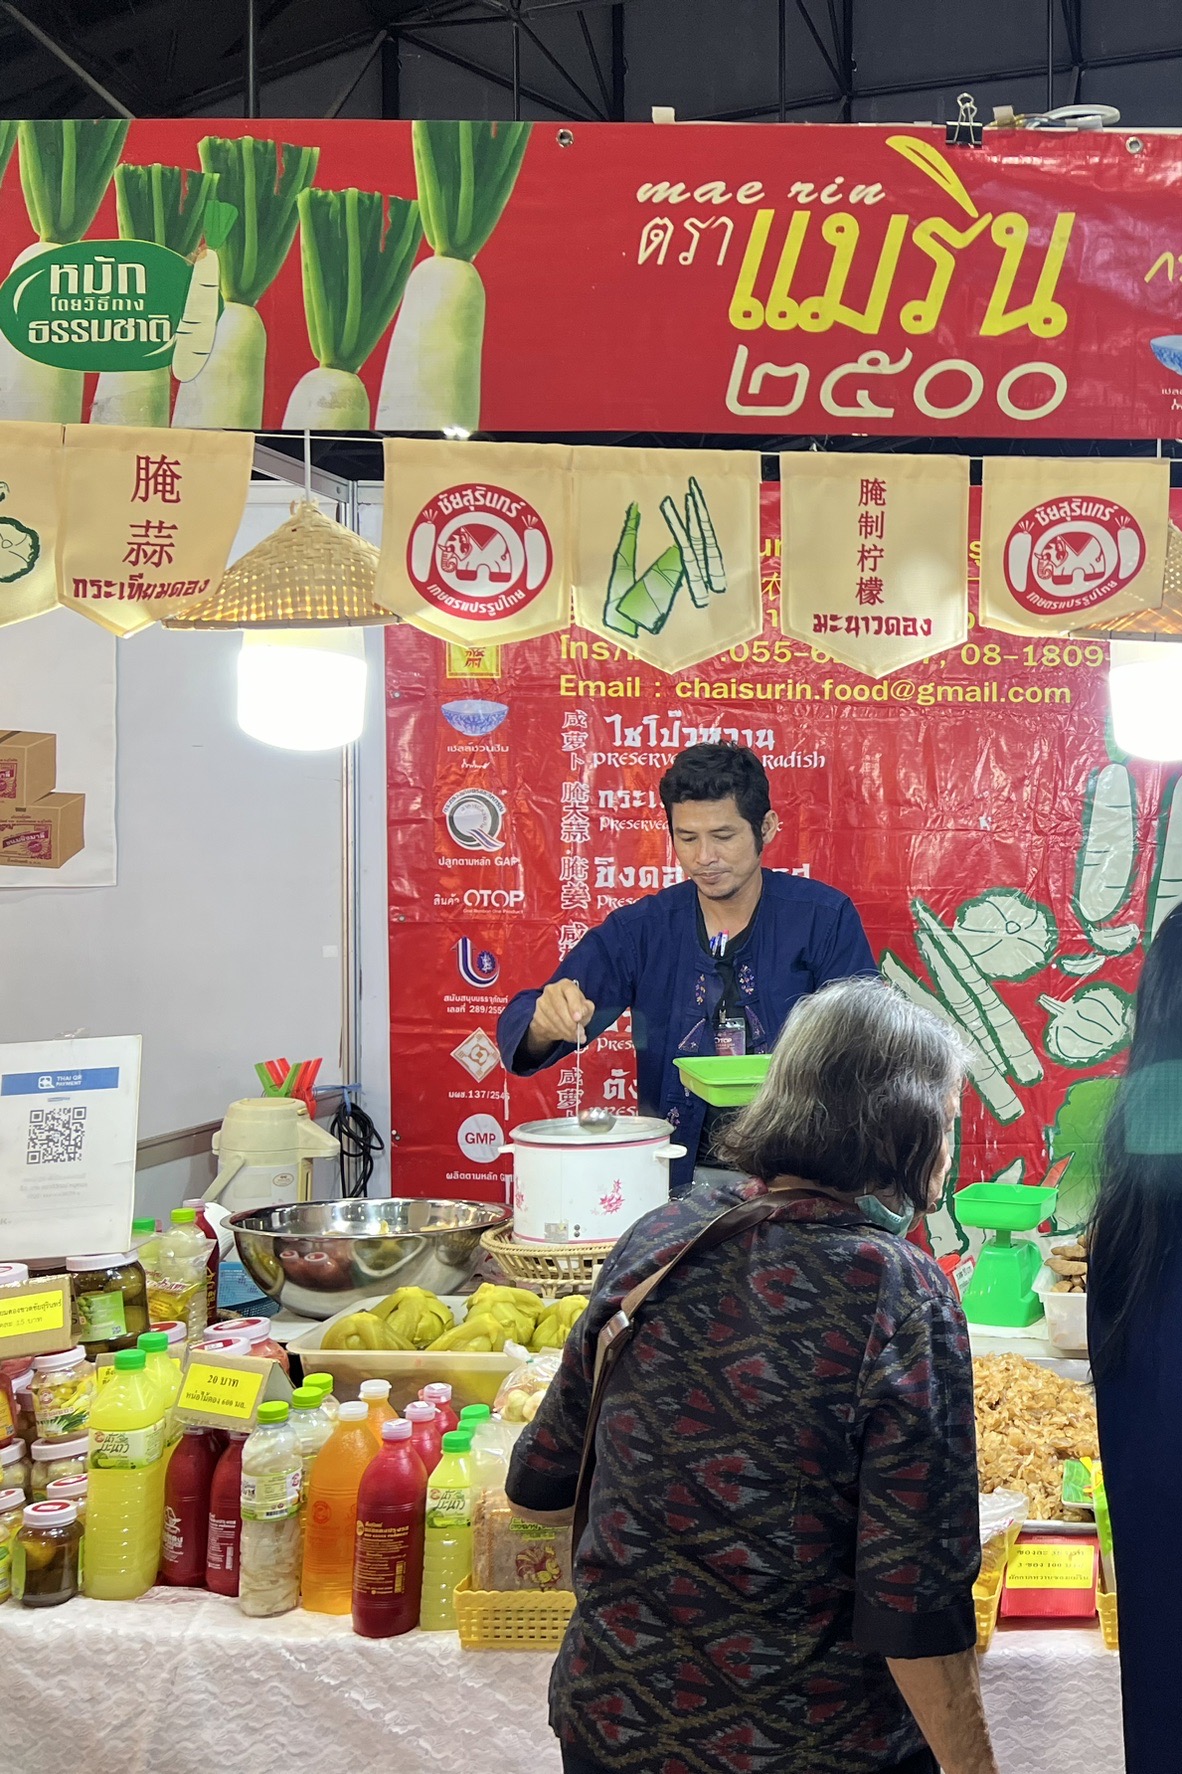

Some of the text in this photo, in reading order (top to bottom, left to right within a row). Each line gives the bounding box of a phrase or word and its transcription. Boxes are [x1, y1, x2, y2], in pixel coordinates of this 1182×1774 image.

[636, 175, 886, 206] mae rin
[636, 215, 734, 266] ตรา
[49, 256, 147, 296] หมัก
[28, 313, 172, 345] ธรรมชาติ
[725, 343, 1069, 421] ๒๕๐๐
[122, 454, 183, 569] 腌蒜
[437, 485, 528, 520] ชัยสุรินทร์
[1034, 497, 1119, 528] ชัยสุรินทร์
[854, 477, 888, 607] 腌制柠檬
[72, 572, 211, 601] กระเทียมดอง
[426, 582, 527, 617] เกษตรแปรรูปไทย
[812, 612, 934, 638] มะนาวดอง
[559, 674, 641, 698] Email
[674, 676, 1072, 707] chaisurin.food@gmail.com
[438, 857, 520, 869] ปลูกตามหลัก GAP
[433, 888, 525, 908] สินค้า OTOP
[464, 1132, 497, 1146] GMP
[445, 1170, 498, 1182] ผลิตตามหลัก
[207, 1374, 240, 1388] 20 บาท
